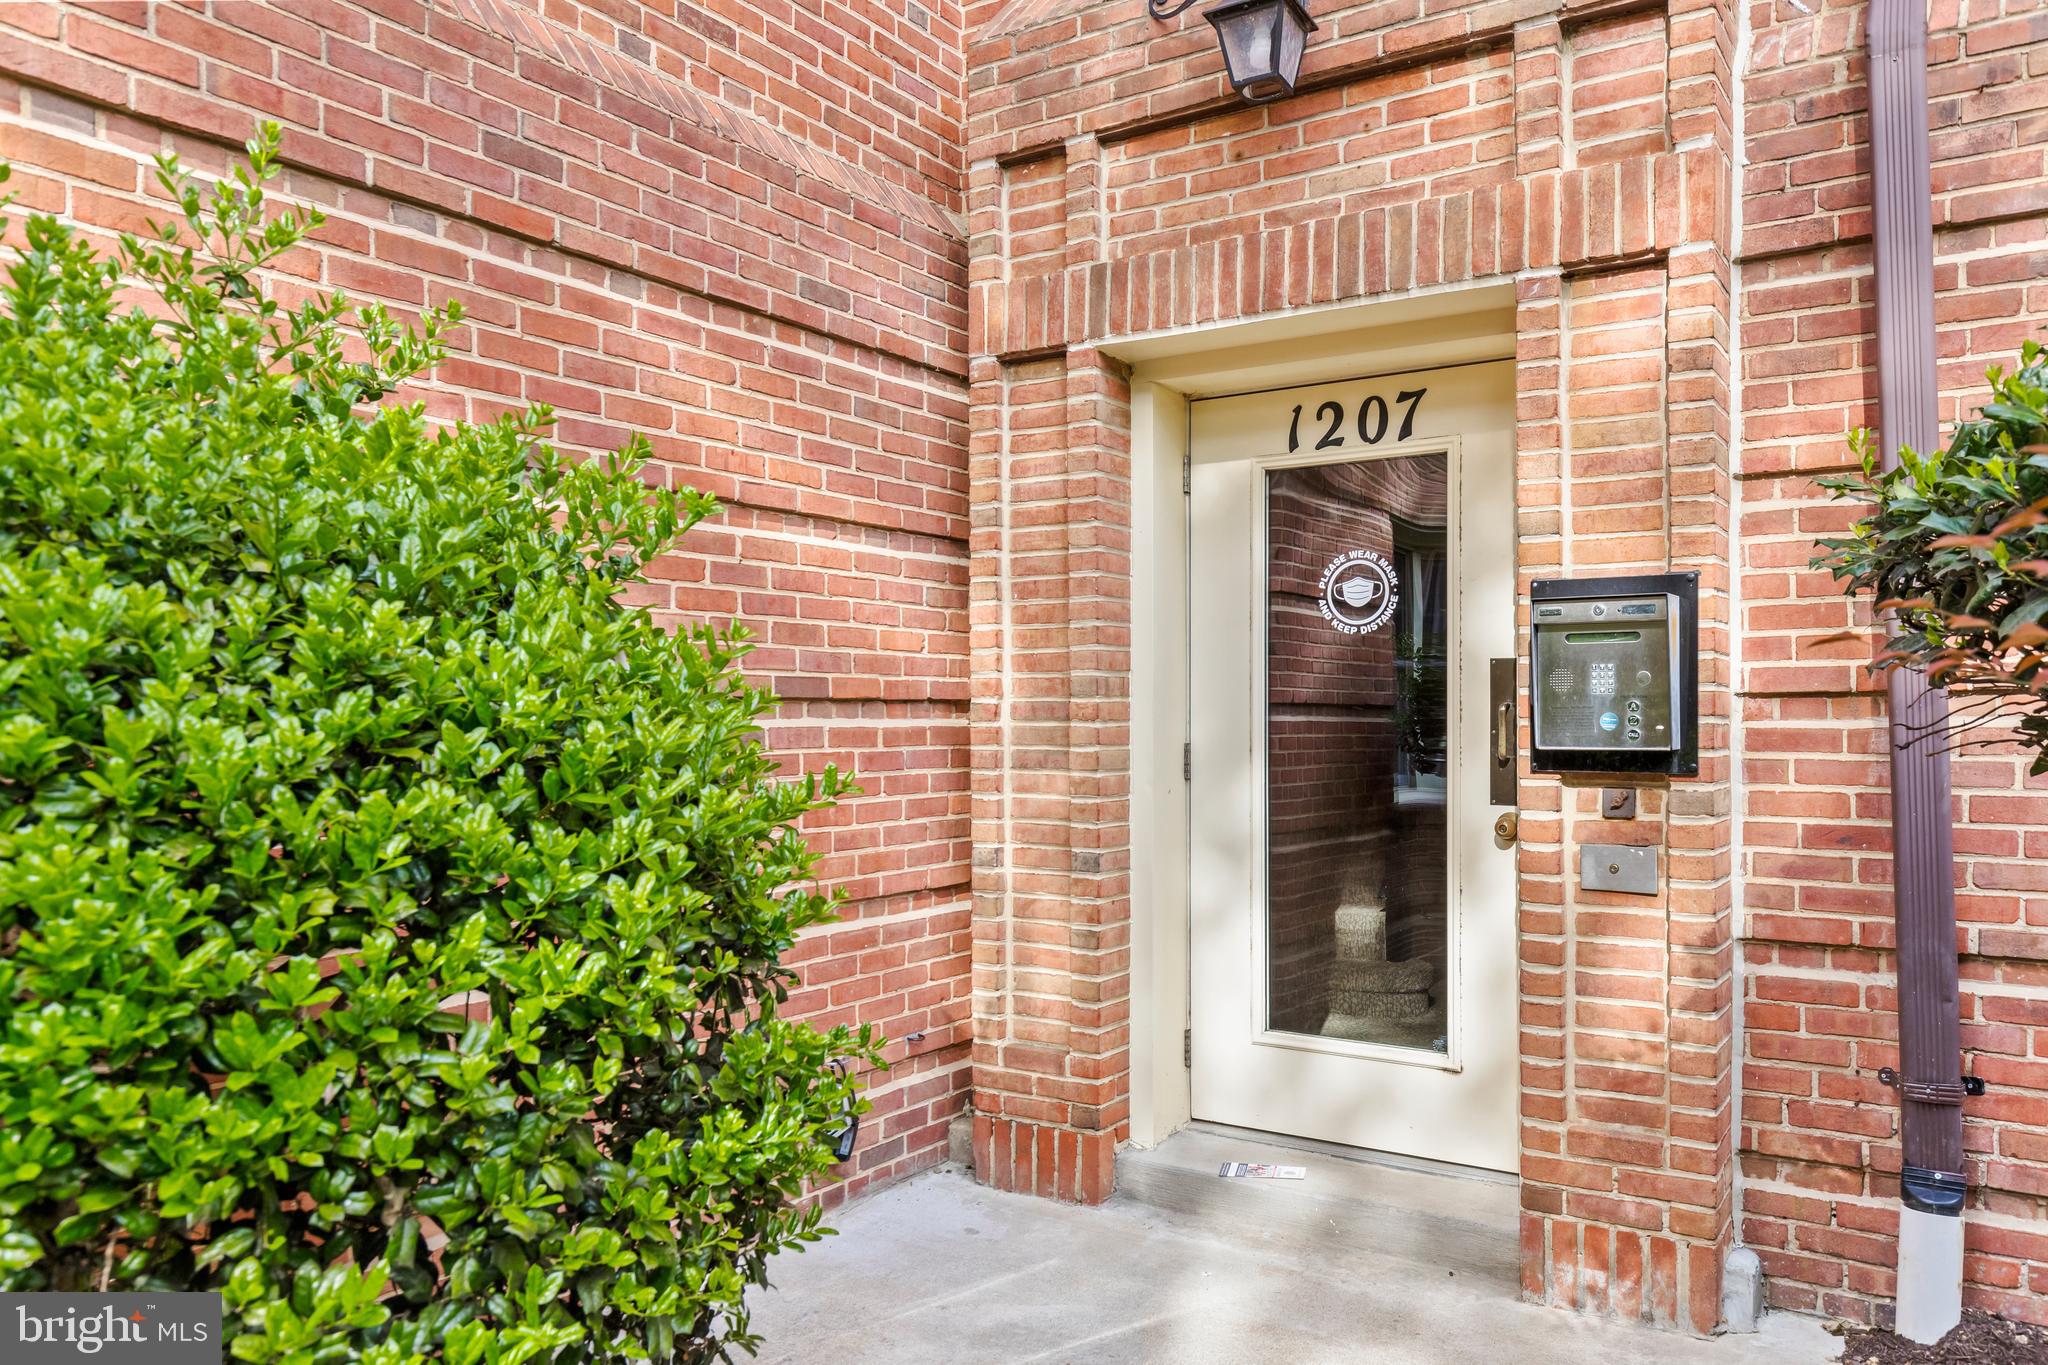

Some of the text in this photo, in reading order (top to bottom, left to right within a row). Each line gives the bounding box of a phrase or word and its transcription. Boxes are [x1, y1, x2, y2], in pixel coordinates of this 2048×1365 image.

[1289, 388, 1427, 453] 1207
[1318, 550, 1399, 589] PLEASE WEAR MASK
[1318, 594, 1399, 635] AND KEEP DISTANCE
